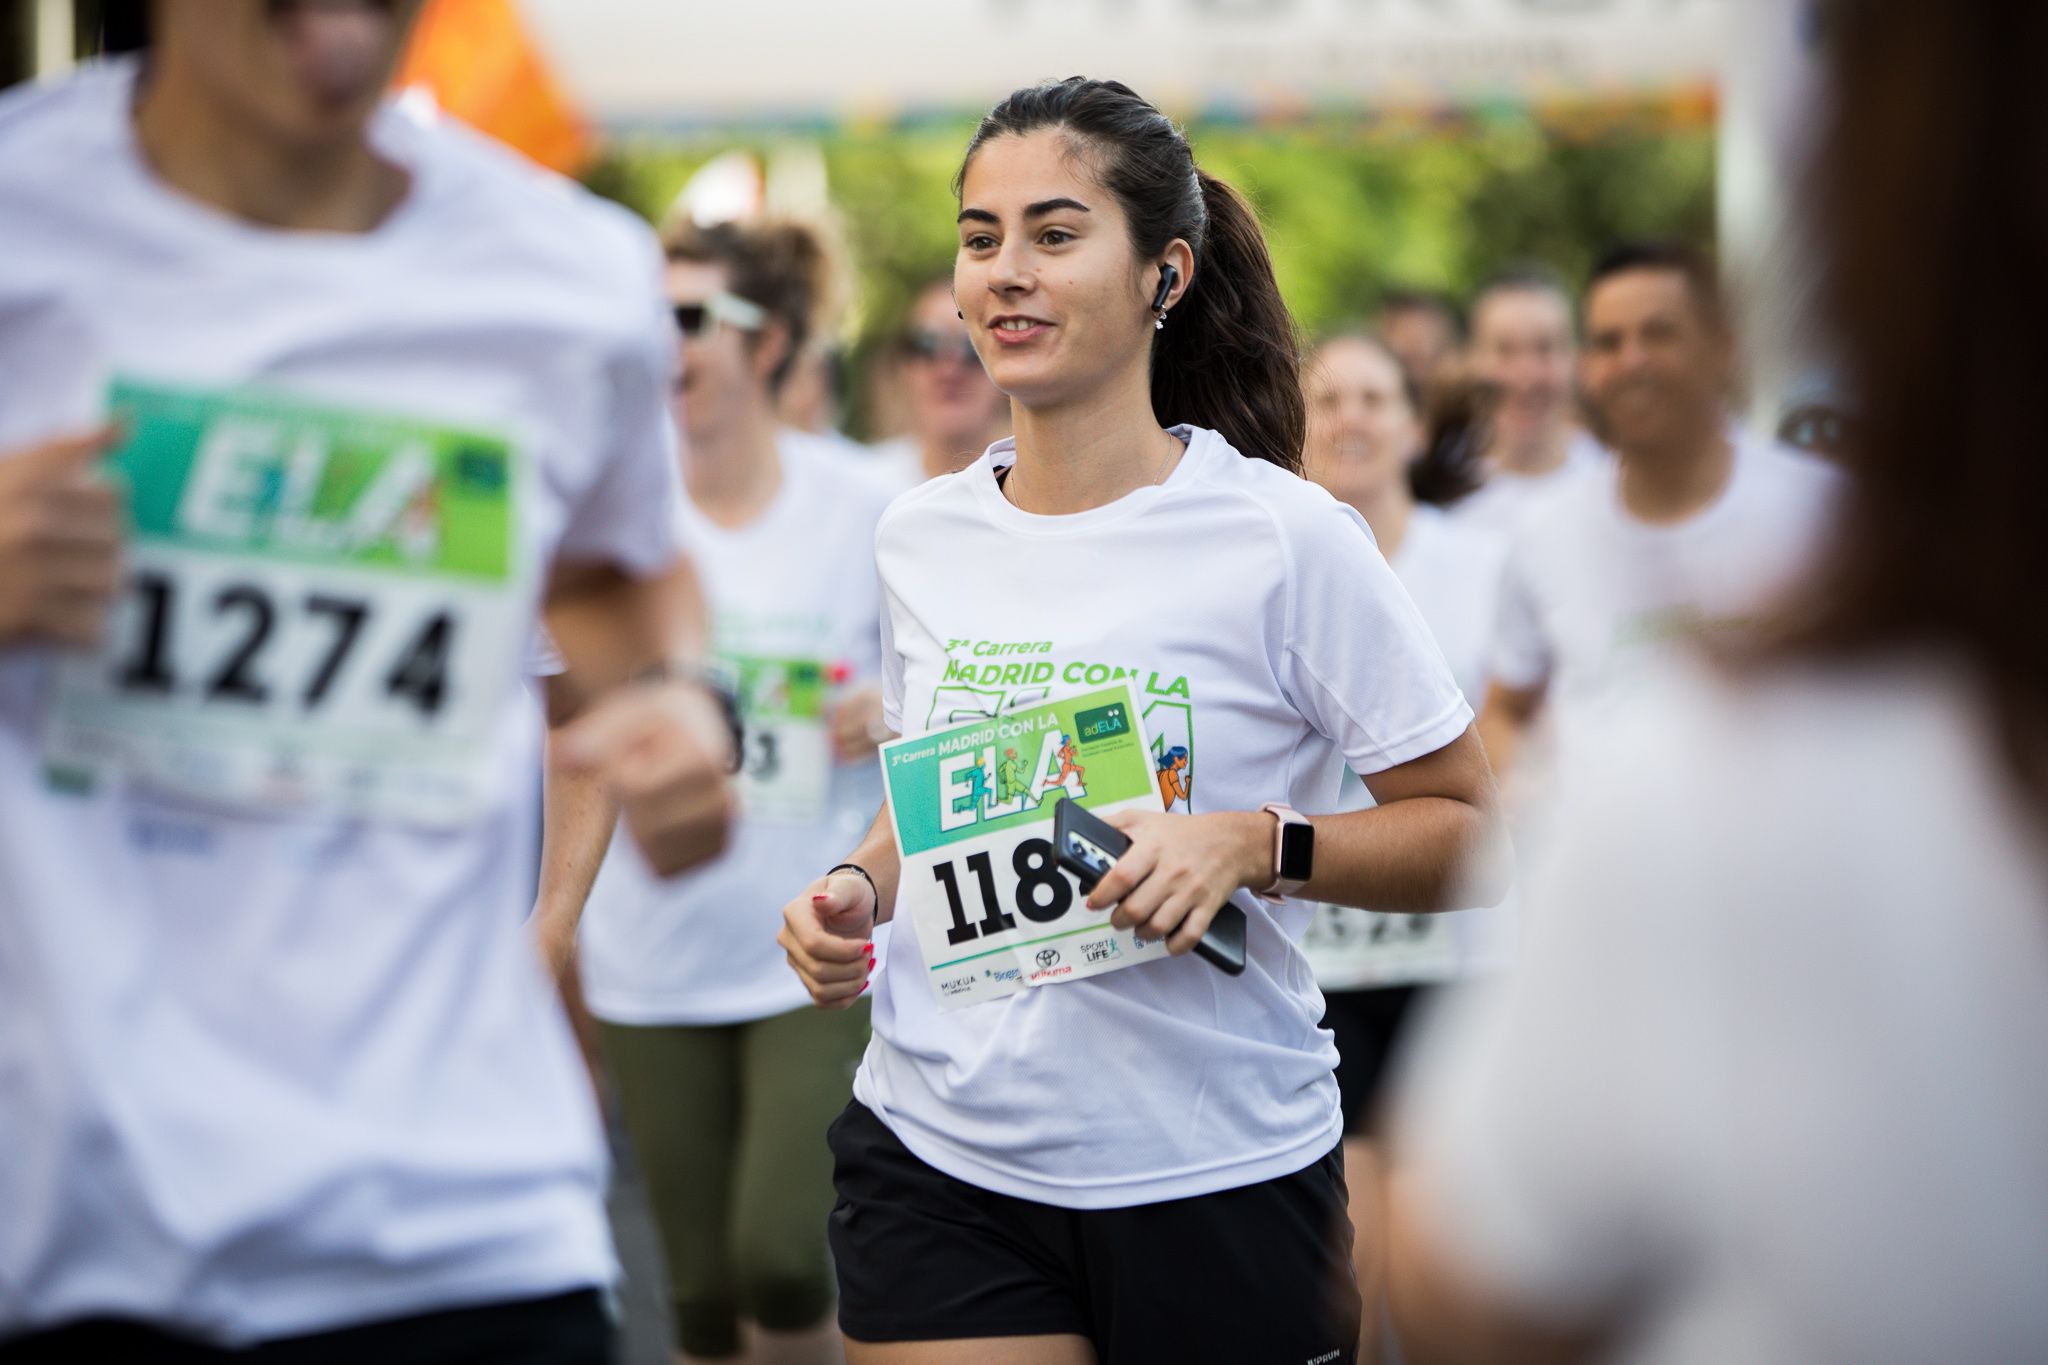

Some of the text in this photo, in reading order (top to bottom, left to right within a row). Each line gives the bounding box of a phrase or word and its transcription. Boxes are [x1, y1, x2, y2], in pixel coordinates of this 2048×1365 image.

[178, 417, 441, 558] ELA
[113, 570, 455, 721] 1274
[973, 640, 1053, 657] Carrera
[942, 660, 1055, 686] MADRID
[1145, 671, 1190, 699] LA
[902, 747, 936, 763] Carrera
[938, 729, 995, 756] MADRID
[997, 719, 1034, 739] CON
[1038, 713, 1059, 730] LA
[1084, 718, 1122, 737] adELA
[938, 729, 1088, 833] ELA
[932, 838, 1094, 947] 118
[1080, 940, 1109, 953] SPORT
[1086, 950, 1109, 962] LIFE
[941, 975, 976, 991] MUKUA
